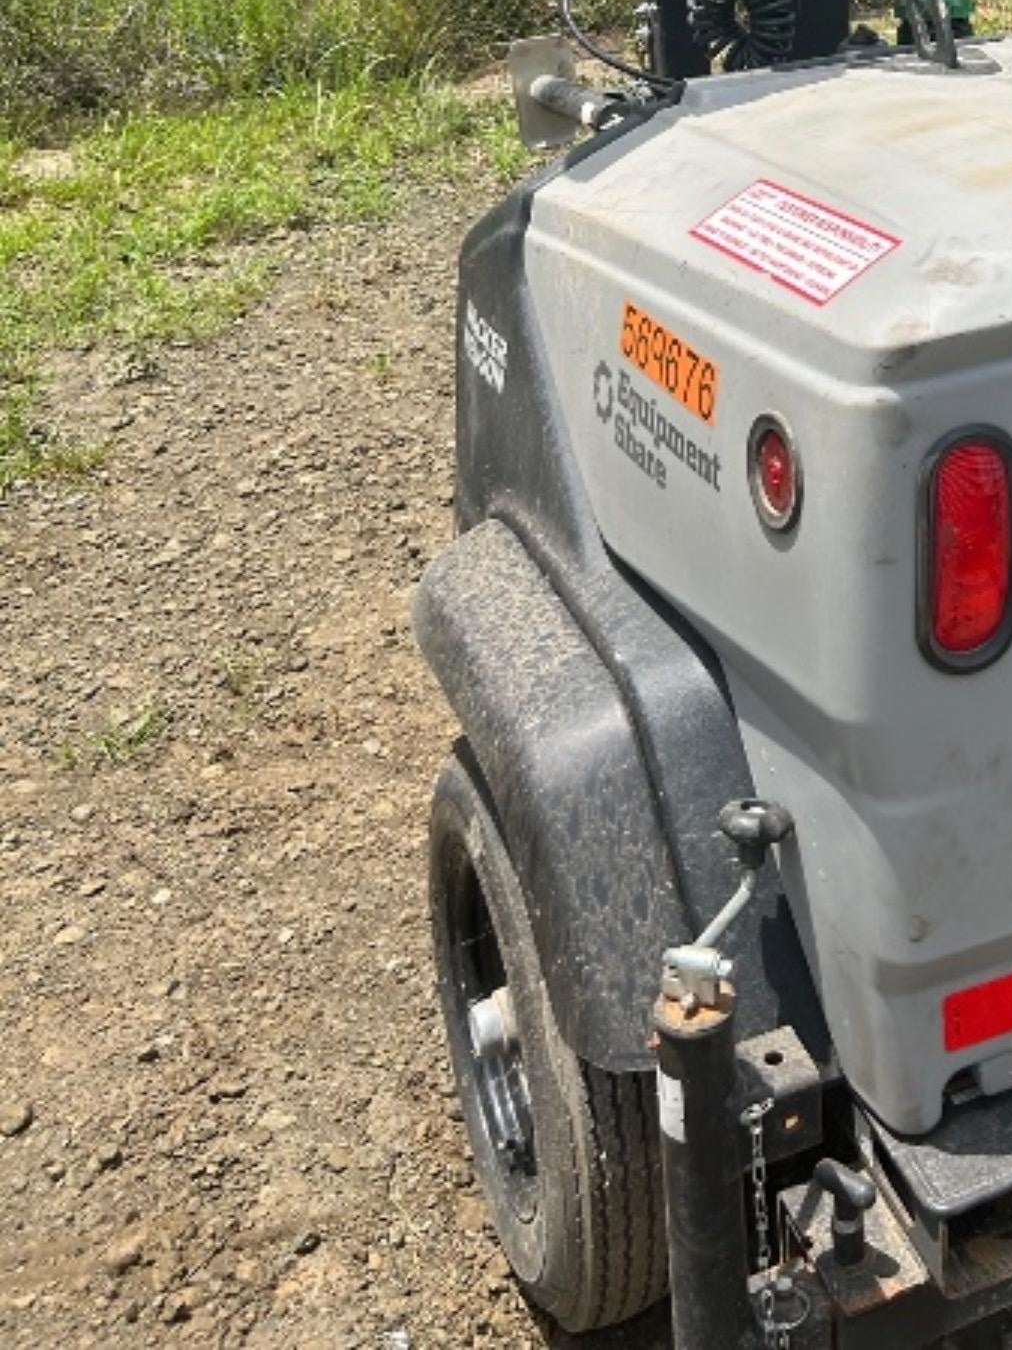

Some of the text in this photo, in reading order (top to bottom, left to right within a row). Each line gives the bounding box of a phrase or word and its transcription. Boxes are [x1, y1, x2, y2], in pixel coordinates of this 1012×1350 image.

[623, 304, 716, 421] 569676
[613, 413, 667, 490] Share
[617, 368, 721, 492] Equipment
